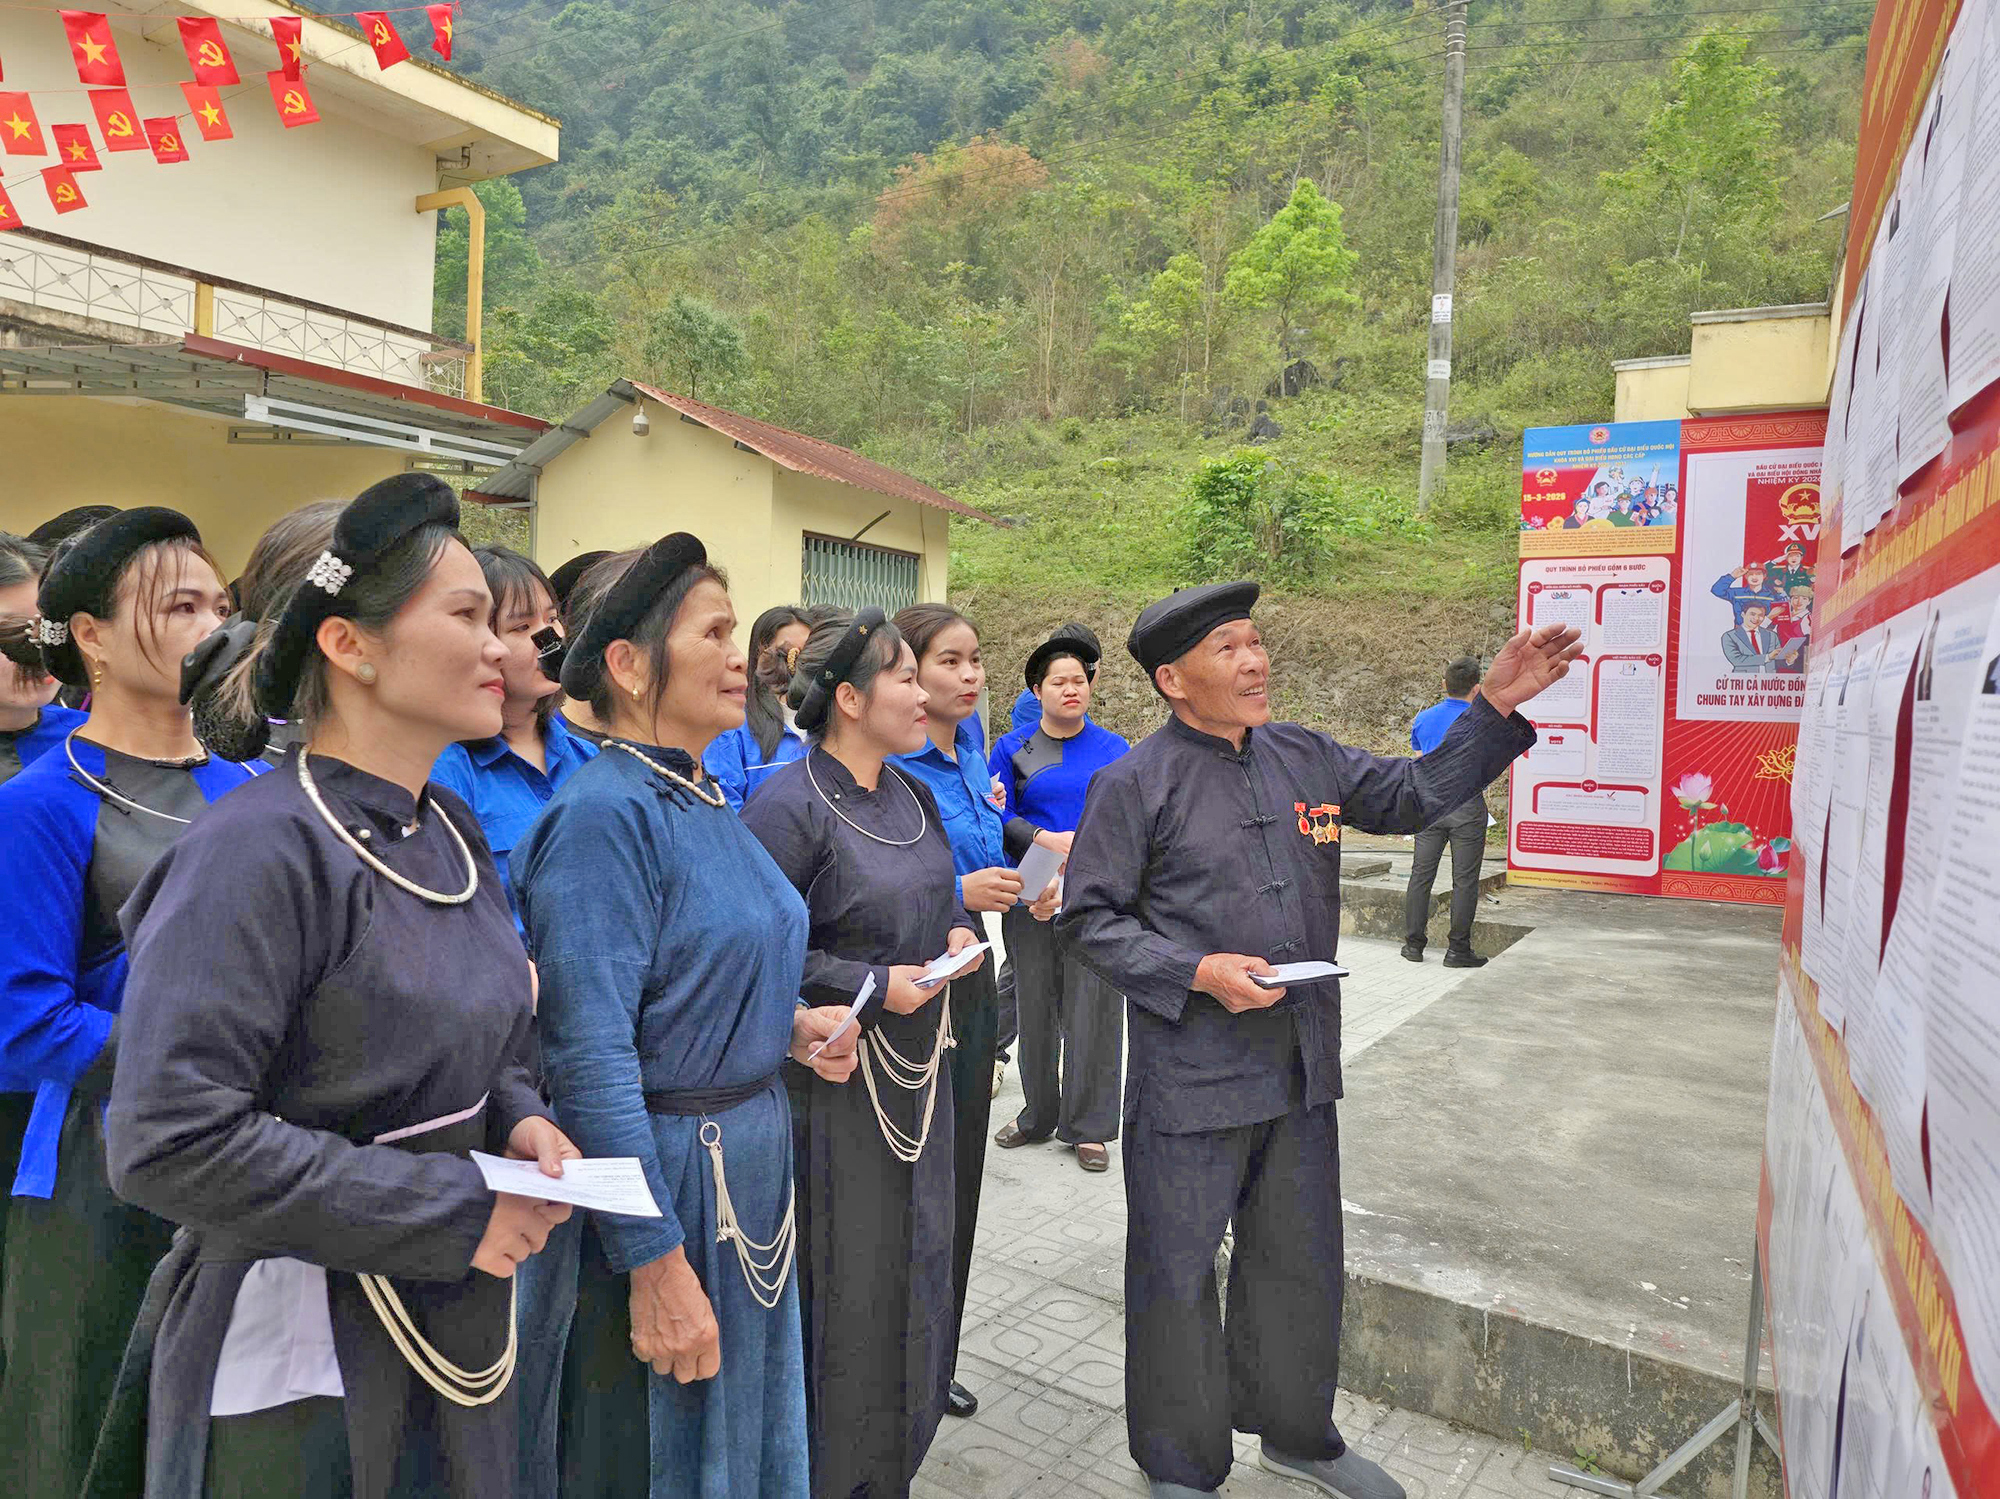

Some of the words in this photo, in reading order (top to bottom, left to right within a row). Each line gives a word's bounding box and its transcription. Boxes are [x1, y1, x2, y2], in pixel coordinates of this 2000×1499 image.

[1588, 563, 1606, 571] PHIẾU
[1716, 674, 1729, 690] CỬ
[1730, 679, 1743, 690] TRI
[1746, 675, 1758, 690] CẢ
[1761, 677, 1785, 691] NƯỚC
[1788, 676, 1806, 691] ĐỒN
[1697, 694, 1726, 705] CHUNG
[1729, 695, 1745, 706] TAY
[1748, 693, 1764, 706] XÂY
[1768, 695, 1792, 709] DỰNG
